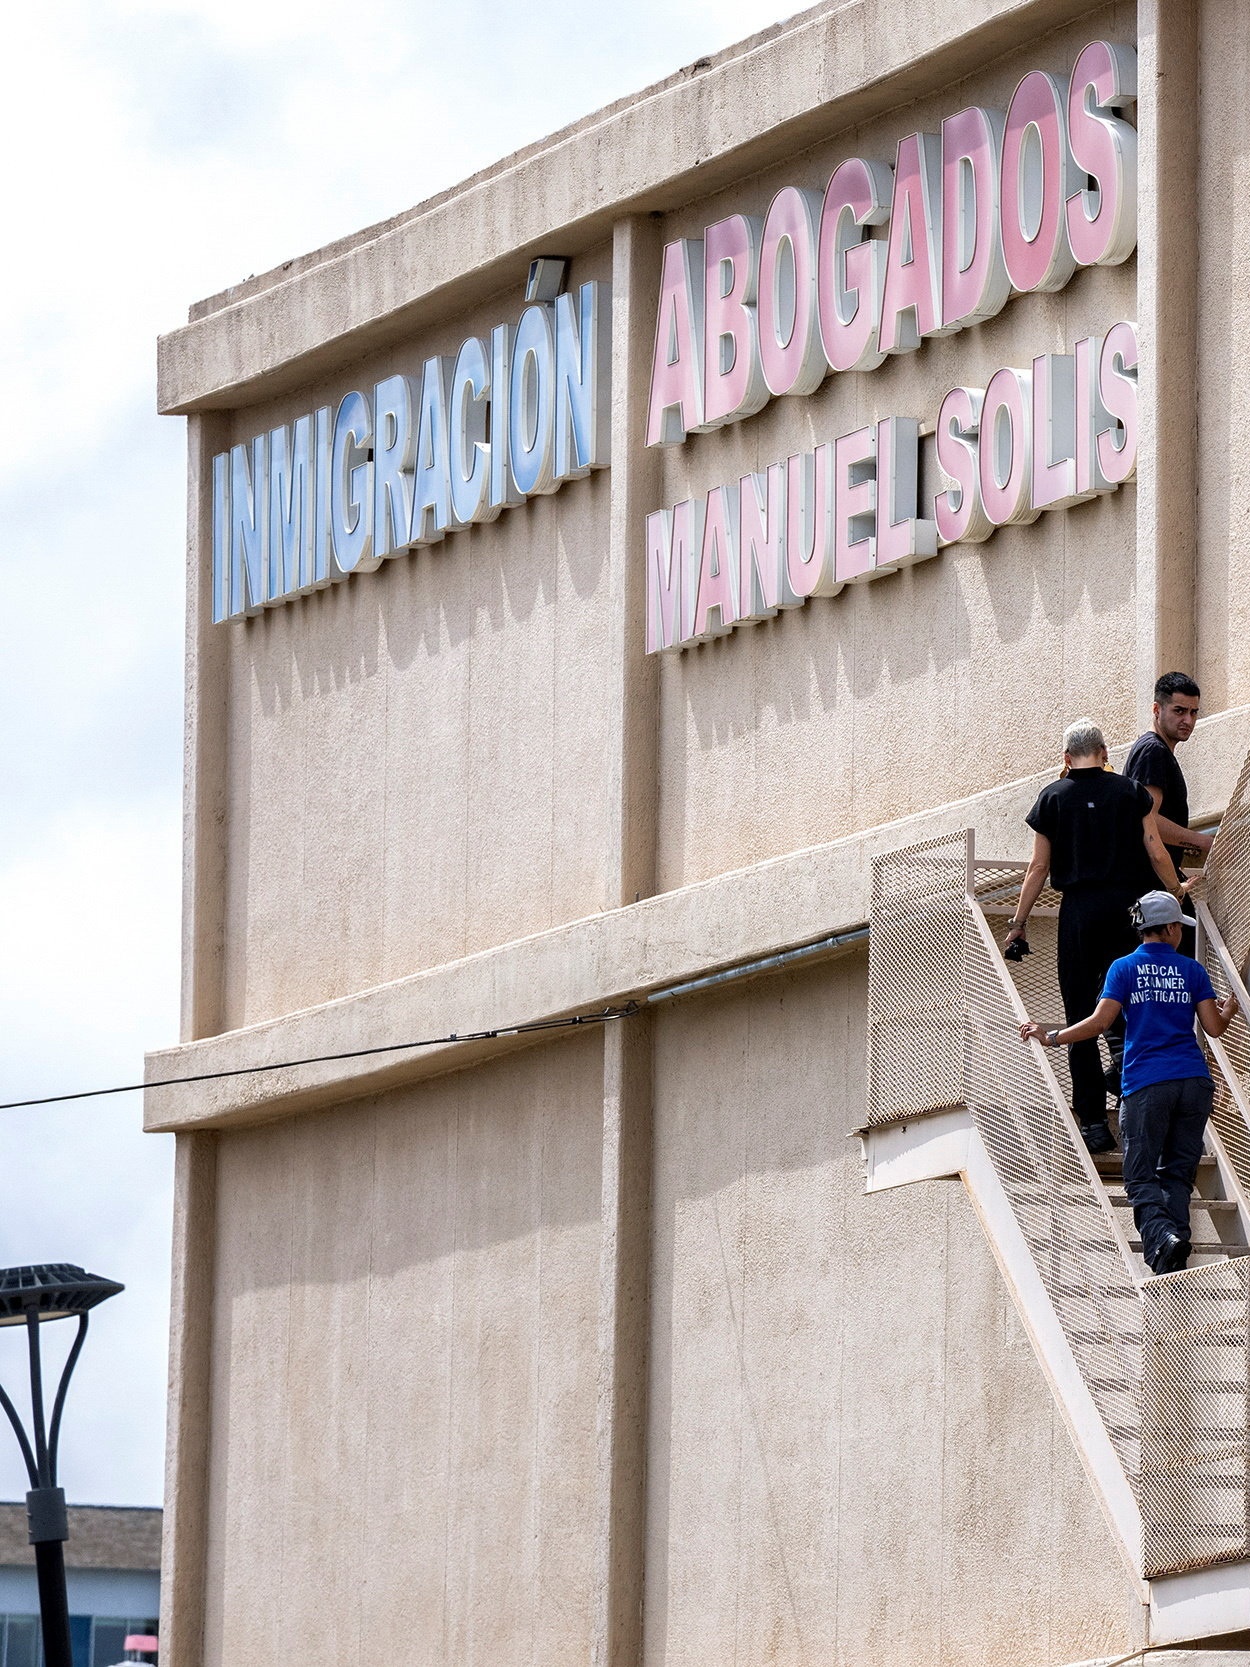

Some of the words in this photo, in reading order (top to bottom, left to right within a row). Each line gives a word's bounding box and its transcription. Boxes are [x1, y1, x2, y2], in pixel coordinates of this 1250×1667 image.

[646, 40, 1137, 448] ABOGADOS
[212, 258, 608, 624] INMIGRACIÓN
[646, 416, 930, 655] MANUEL
[935, 321, 1137, 543] SOLIS
[1136, 963, 1182, 977] MEDCAL
